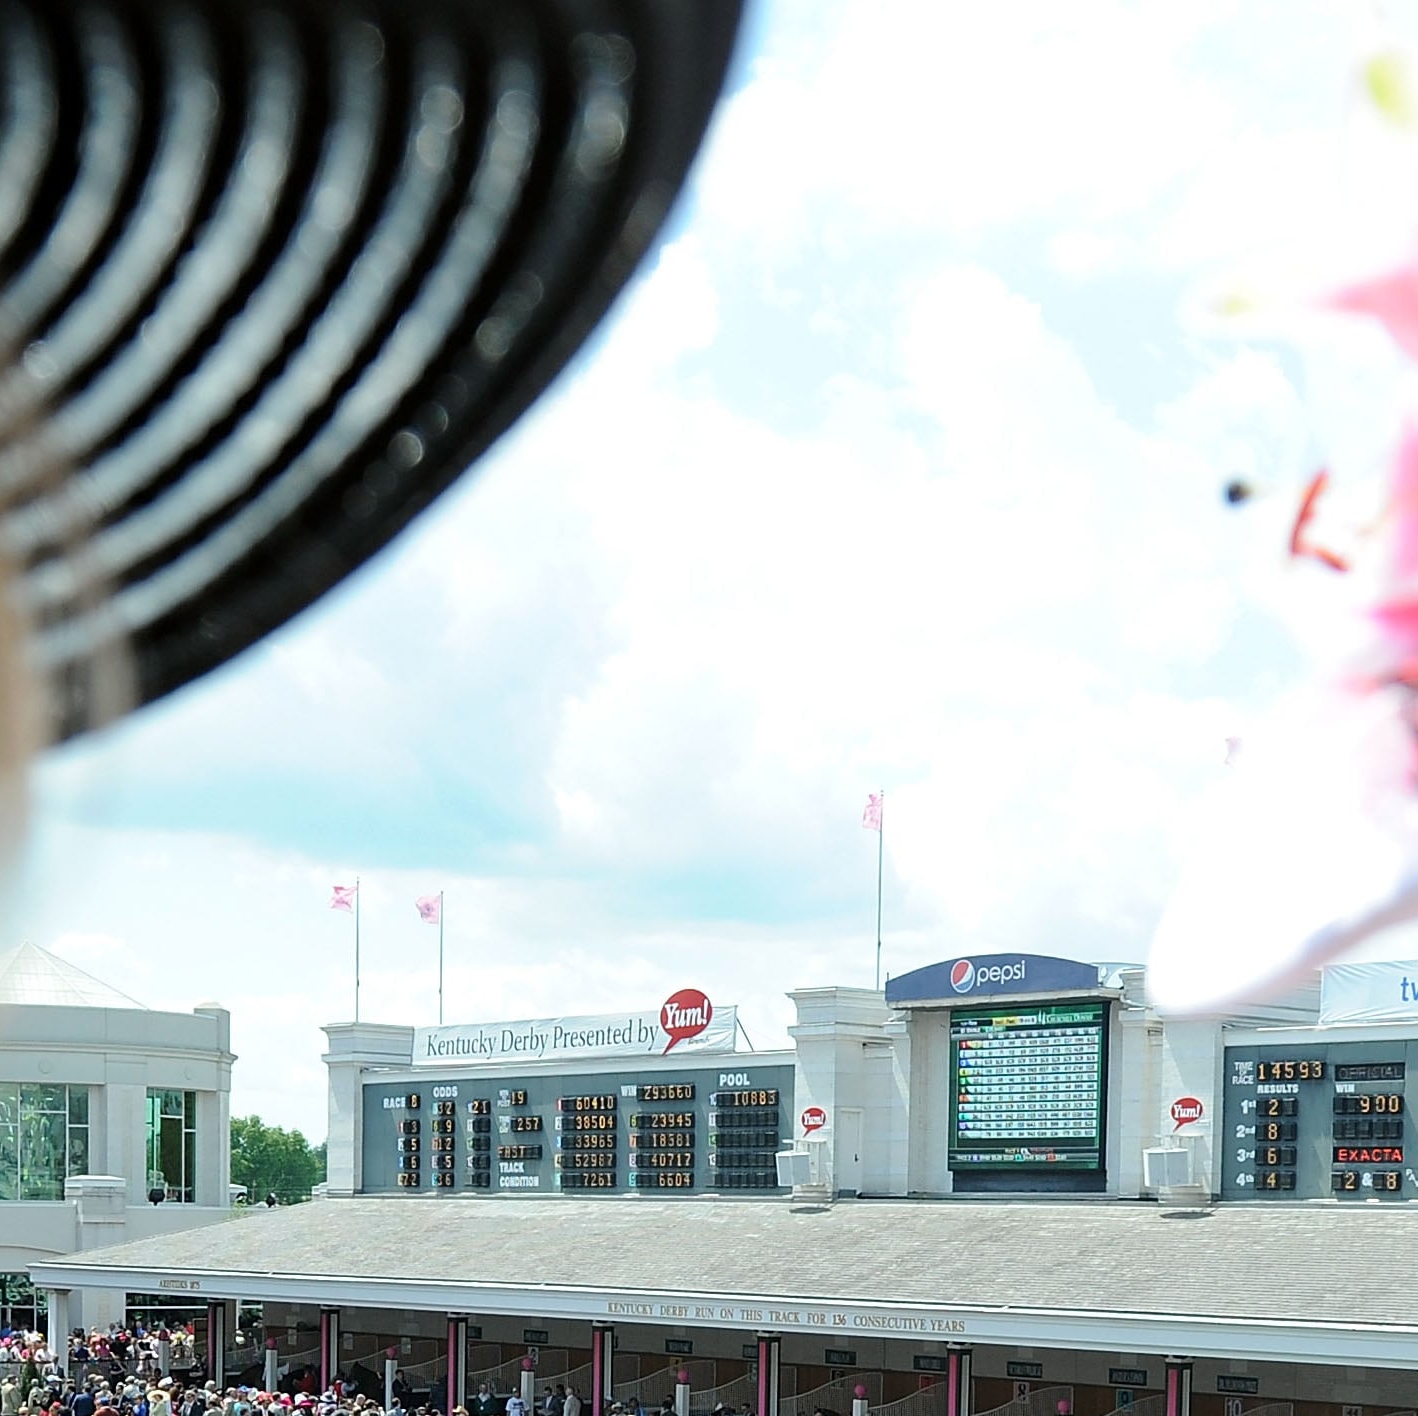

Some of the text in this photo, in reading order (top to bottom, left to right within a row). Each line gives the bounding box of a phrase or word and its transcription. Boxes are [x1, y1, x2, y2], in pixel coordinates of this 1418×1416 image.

[976, 960, 1026, 987] pepsi
[664, 999, 709, 1029] Yum!
[427, 1018, 659, 1060] Kentucky Derby Presented by
[1233, 1062, 1254, 1072] TIME
[720, 1073, 750, 1087] POOL
[1232, 1075, 1255, 1085] RACE
[433, 1086, 458, 1098] ODDS
[1257, 1084, 1300, 1094] RESULTS
[1335, 1084, 1356, 1093] WIN
[383, 1096, 406, 1109] RACE
[411, 1094, 417, 1108] 8
[511, 1090, 525, 1105] 19
[575, 1096, 614, 1110] 60410
[1359, 1095, 1400, 1112] 900
[1173, 1103, 1201, 1119] Yum!
[1241, 1099, 1256, 1115] 1st
[1268, 1099, 1279, 1116] 2
[411, 1120, 417, 1133] 3
[445, 1119, 452, 1132] 9
[517, 1117, 540, 1131] 257
[575, 1115, 614, 1129] 38504
[651, 1113, 693, 1127] 23945
[1236, 1124, 1255, 1138] 2nd
[1268, 1123, 1278, 1140] 8
[411, 1138, 417, 1150] 5
[575, 1134, 614, 1149] 33965
[497, 1146, 526, 1159] FAST
[651, 1152, 692, 1167] 40717
[1236, 1150, 1255, 1163] 3rd
[1267, 1148, 1277, 1165] 6
[1338, 1149, 1403, 1163] EXACTA
[410, 1156, 417, 1169] 6
[445, 1156, 452, 1169] 5
[499, 1162, 525, 1173] TRACK
[499, 1175, 540, 1188] CONDITION
[582, 1173, 613, 1187] 7261
[659, 1173, 691, 1186] 6604
[1236, 1173, 1254, 1187] 4th
[1267, 1172, 1276, 1188] 4
[1345, 1172, 1356, 1190] 2
[1386, 1172, 1397, 1189] 8
[608, 1302, 966, 1333] KENTUCKY DERBY RUN ON THIS TRACK FOR 136 CONSECUTIVE YEARS
